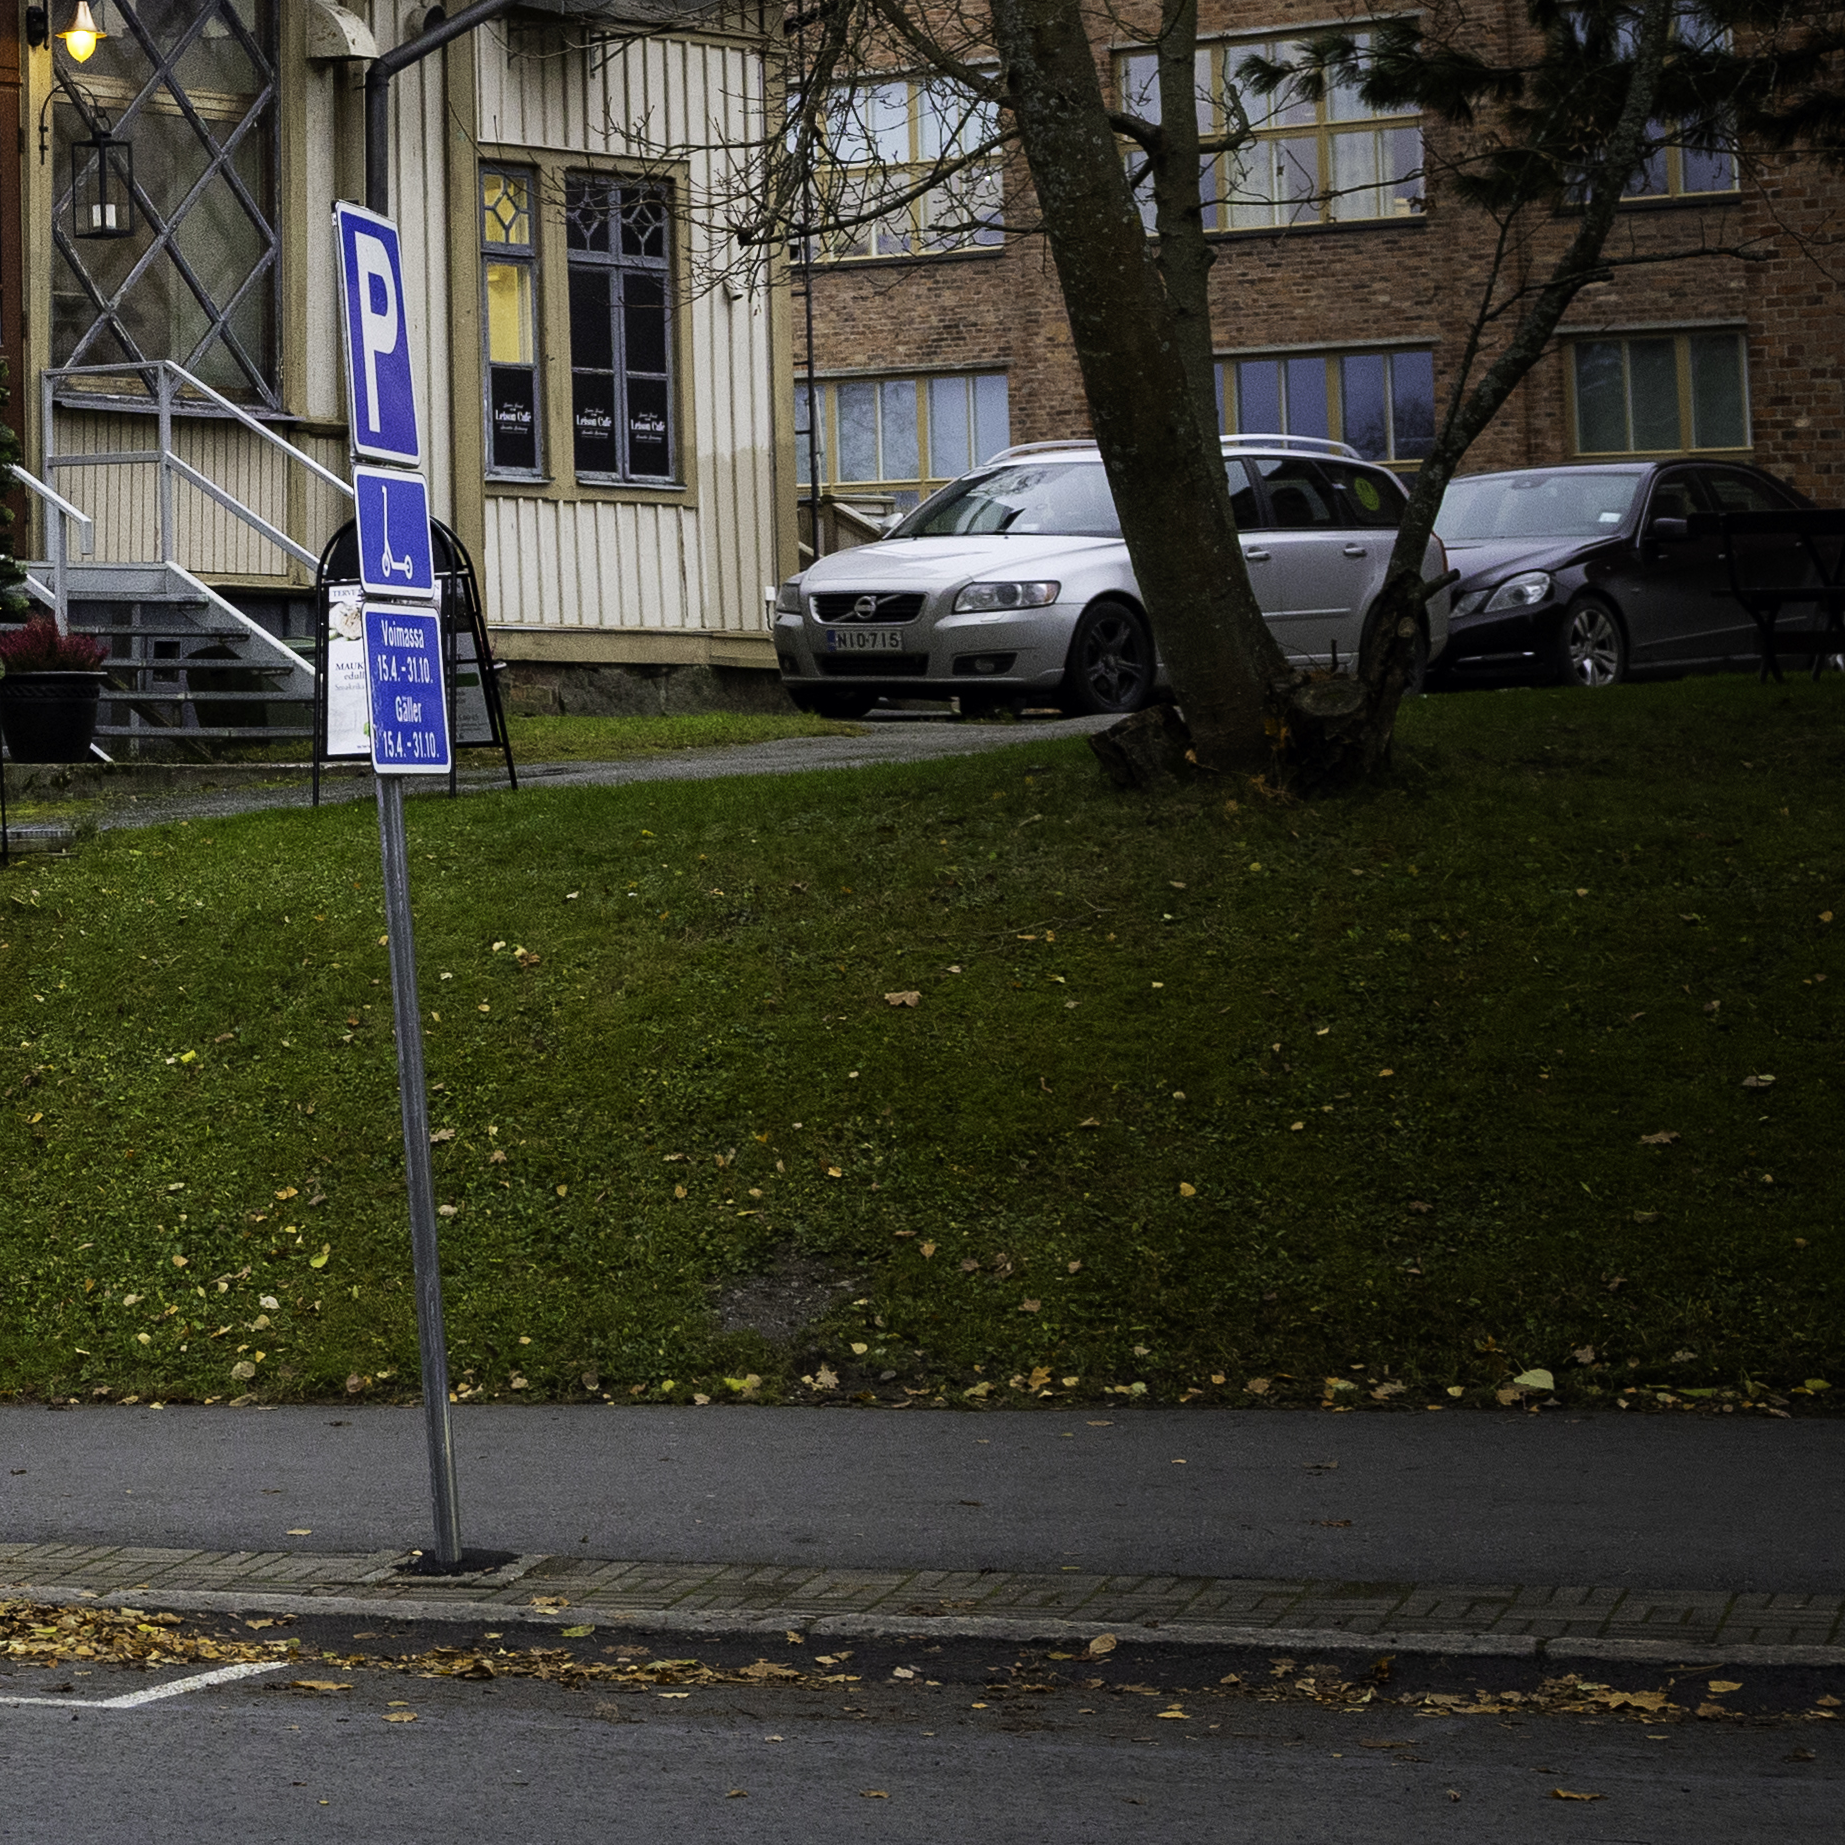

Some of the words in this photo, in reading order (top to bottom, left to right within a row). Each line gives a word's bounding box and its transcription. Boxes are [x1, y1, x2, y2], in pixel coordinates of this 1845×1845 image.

[354, 230, 399, 434] P
[381, 620, 424, 649] Voimassa
[837, 633, 899, 648] NIO-715
[395, 695, 422, 723] Gäller
